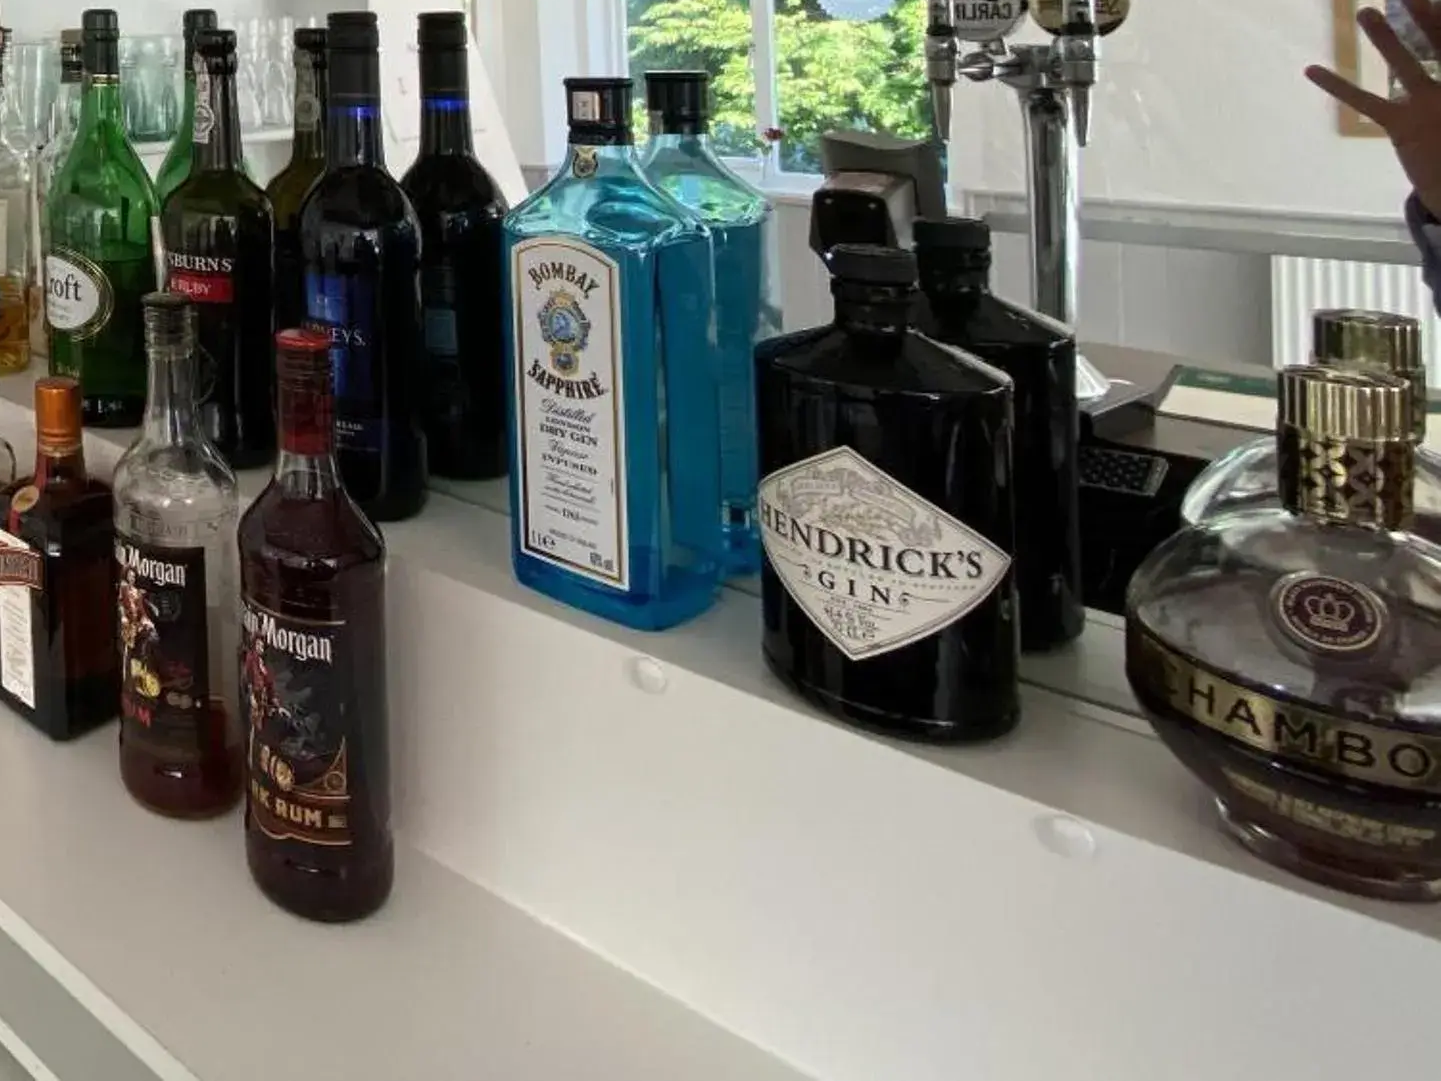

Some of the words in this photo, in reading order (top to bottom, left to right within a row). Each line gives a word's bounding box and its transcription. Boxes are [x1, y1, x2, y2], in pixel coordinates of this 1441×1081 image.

[528, 261, 601, 299] BOMBAY
[527, 358, 606, 400] SAPPHIRE
[126, 544, 186, 589] Morgan
[818, 570, 891, 605] GIN
[258, 611, 332, 665] Morgan
[275, 796, 322, 829] RUM
